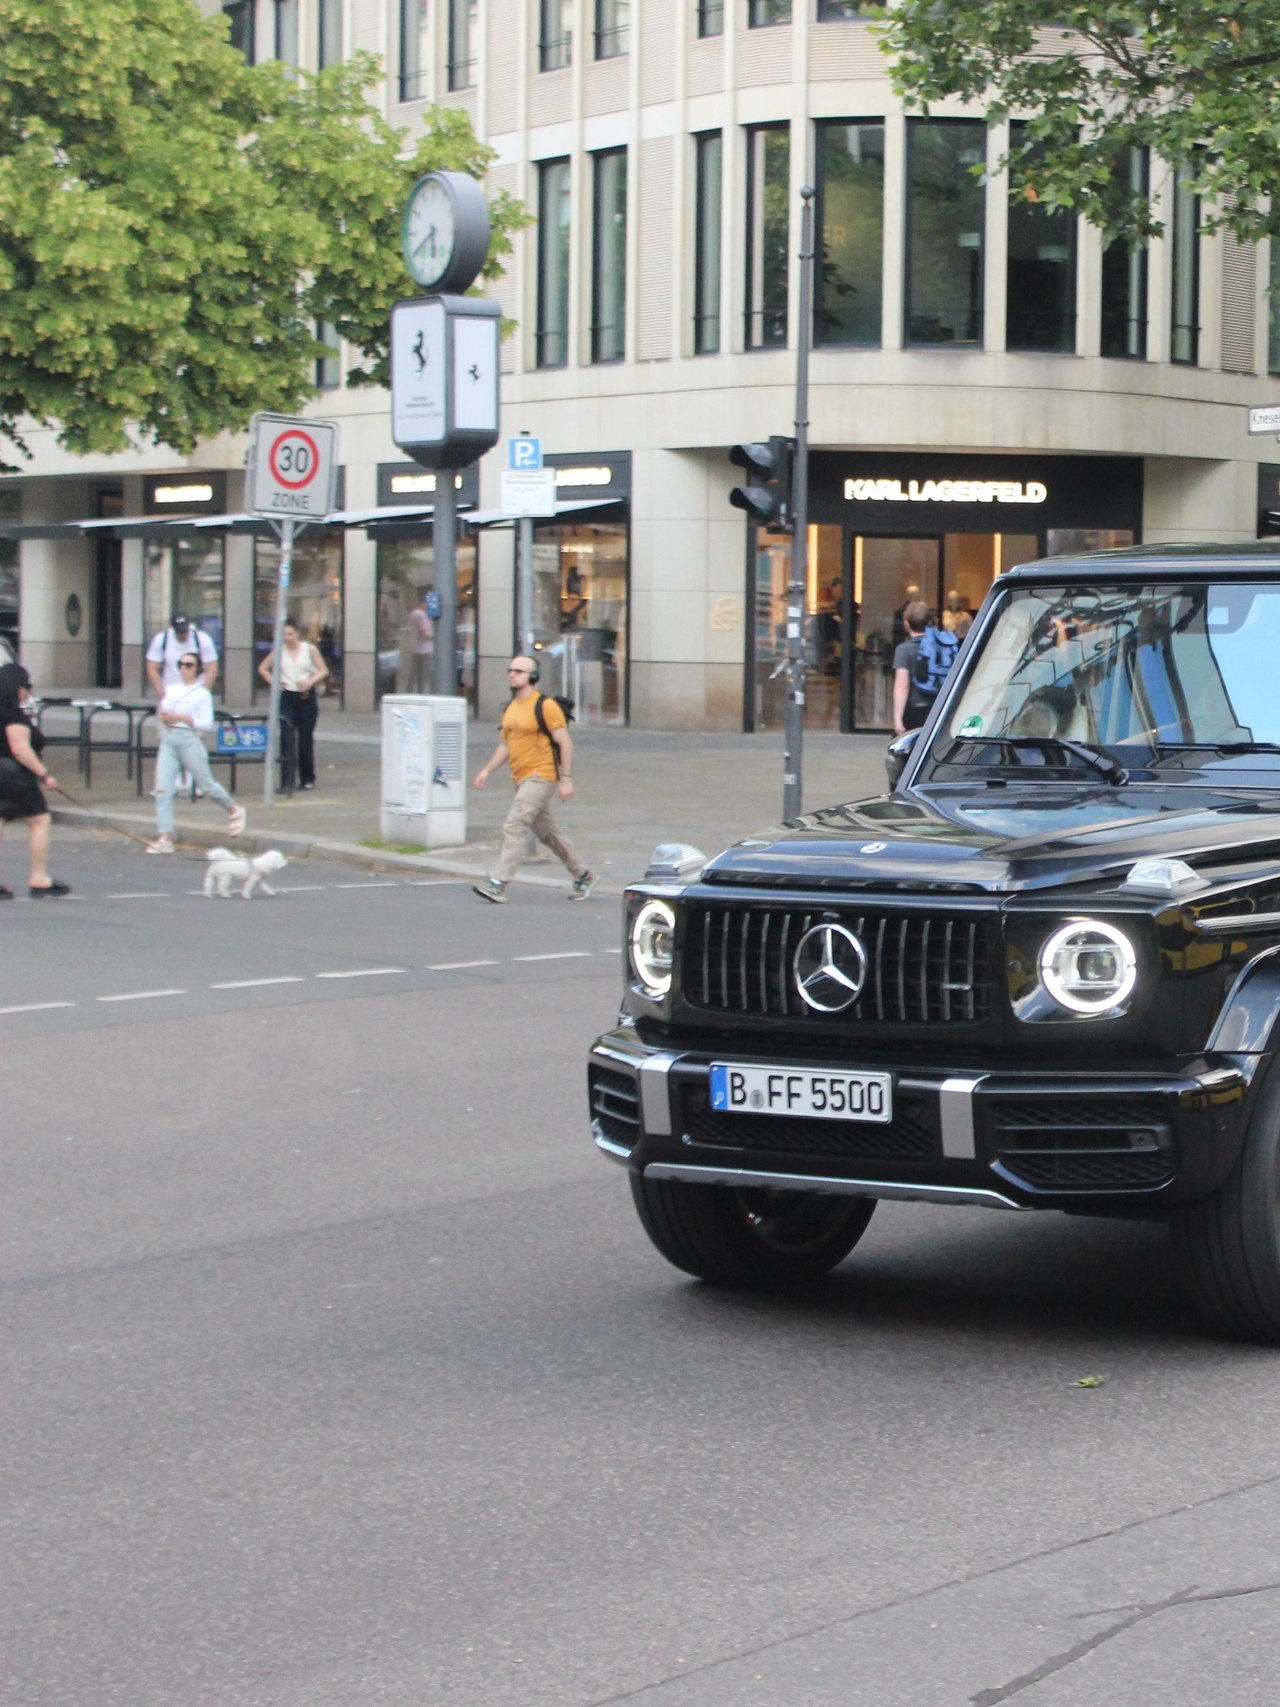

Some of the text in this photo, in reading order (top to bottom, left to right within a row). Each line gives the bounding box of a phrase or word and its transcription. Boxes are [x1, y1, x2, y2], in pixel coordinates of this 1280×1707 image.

[279, 445, 309, 473] 30
[514, 442, 535, 467] P
[271, 492, 310, 509] ZONE
[844, 479, 1047, 503] KARL LAGERFELD
[730, 1072, 883, 1115] B FF 5500
